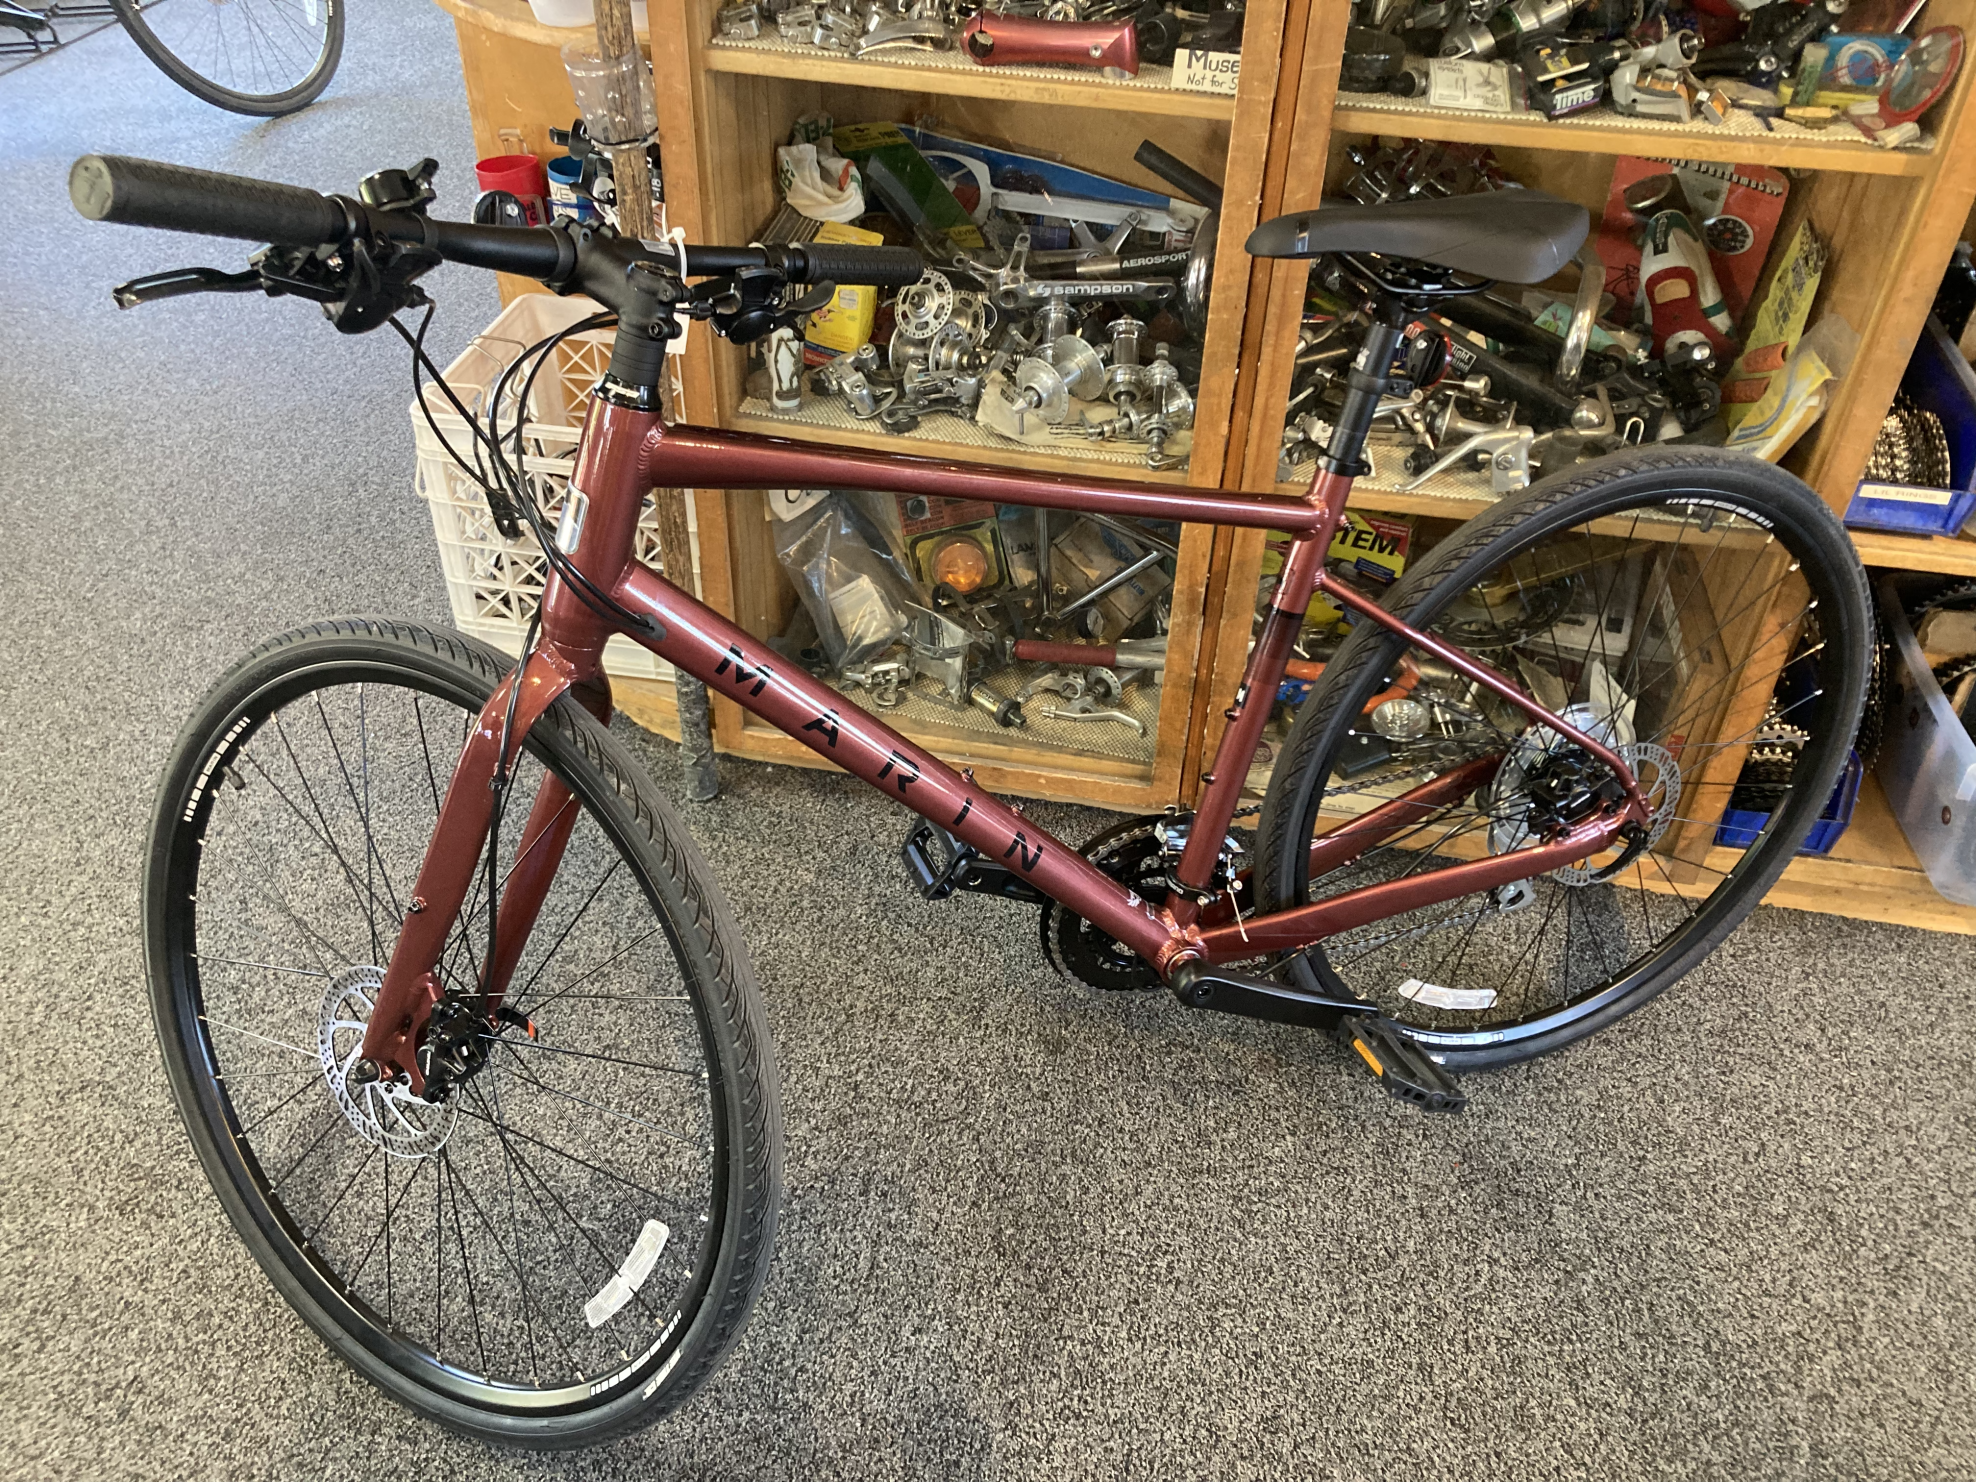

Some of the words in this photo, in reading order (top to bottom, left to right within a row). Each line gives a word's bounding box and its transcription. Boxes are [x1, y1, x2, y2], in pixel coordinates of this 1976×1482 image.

[1187, 72, 1207, 87] Not
[1210, 75, 1226, 88] for
[1554, 88, 1596, 111] Time
[1054, 284, 1133, 296] sampson
[1338, 527, 1401, 556] TEM
[715, 643, 1044, 874] MARIN
